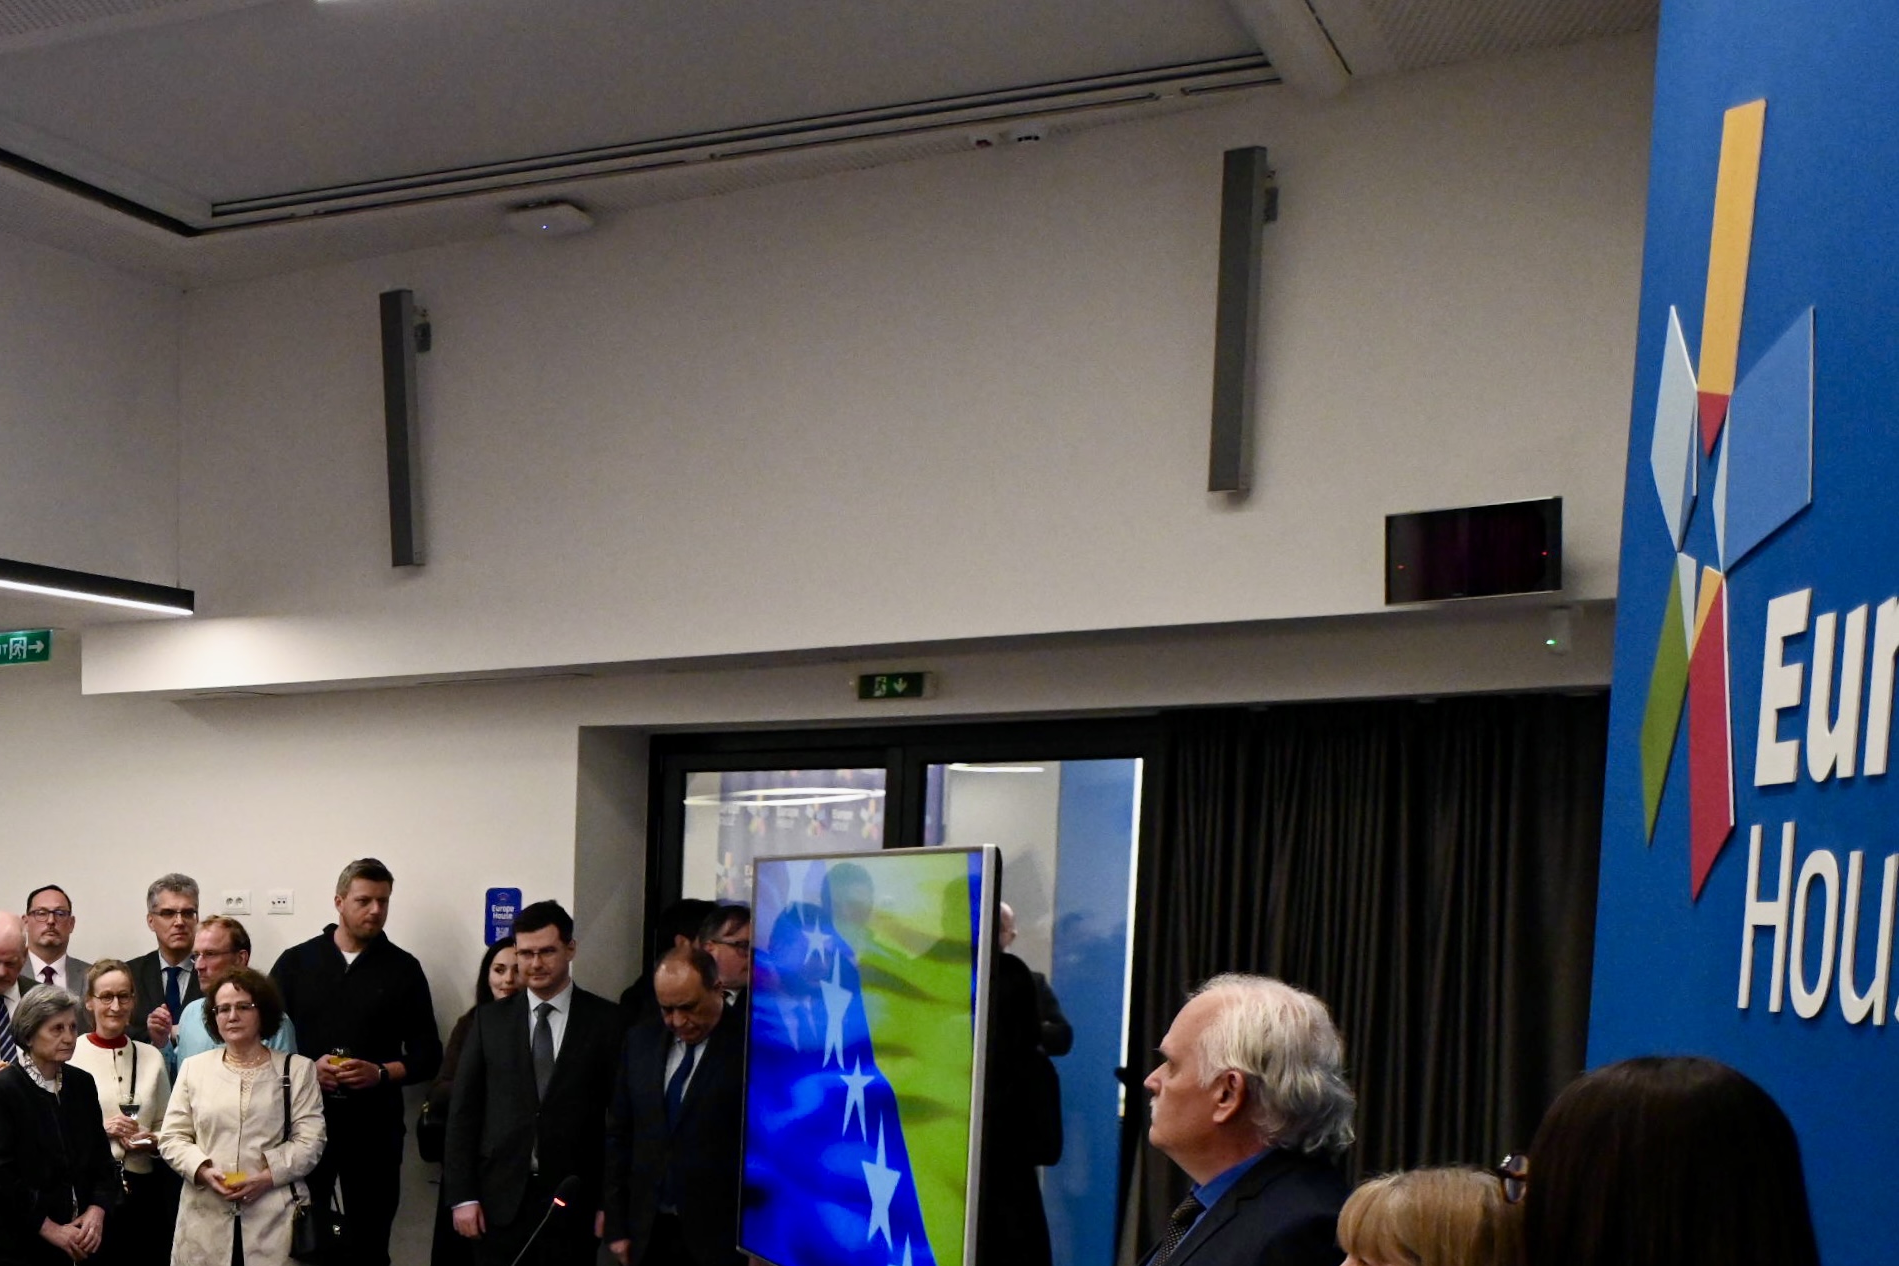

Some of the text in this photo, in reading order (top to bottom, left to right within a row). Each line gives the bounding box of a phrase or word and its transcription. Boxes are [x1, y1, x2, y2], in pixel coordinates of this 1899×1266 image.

[1754, 588, 1899, 787] Eur
[491, 905, 515, 913] Europe
[1737, 821, 1899, 1026] Hou
